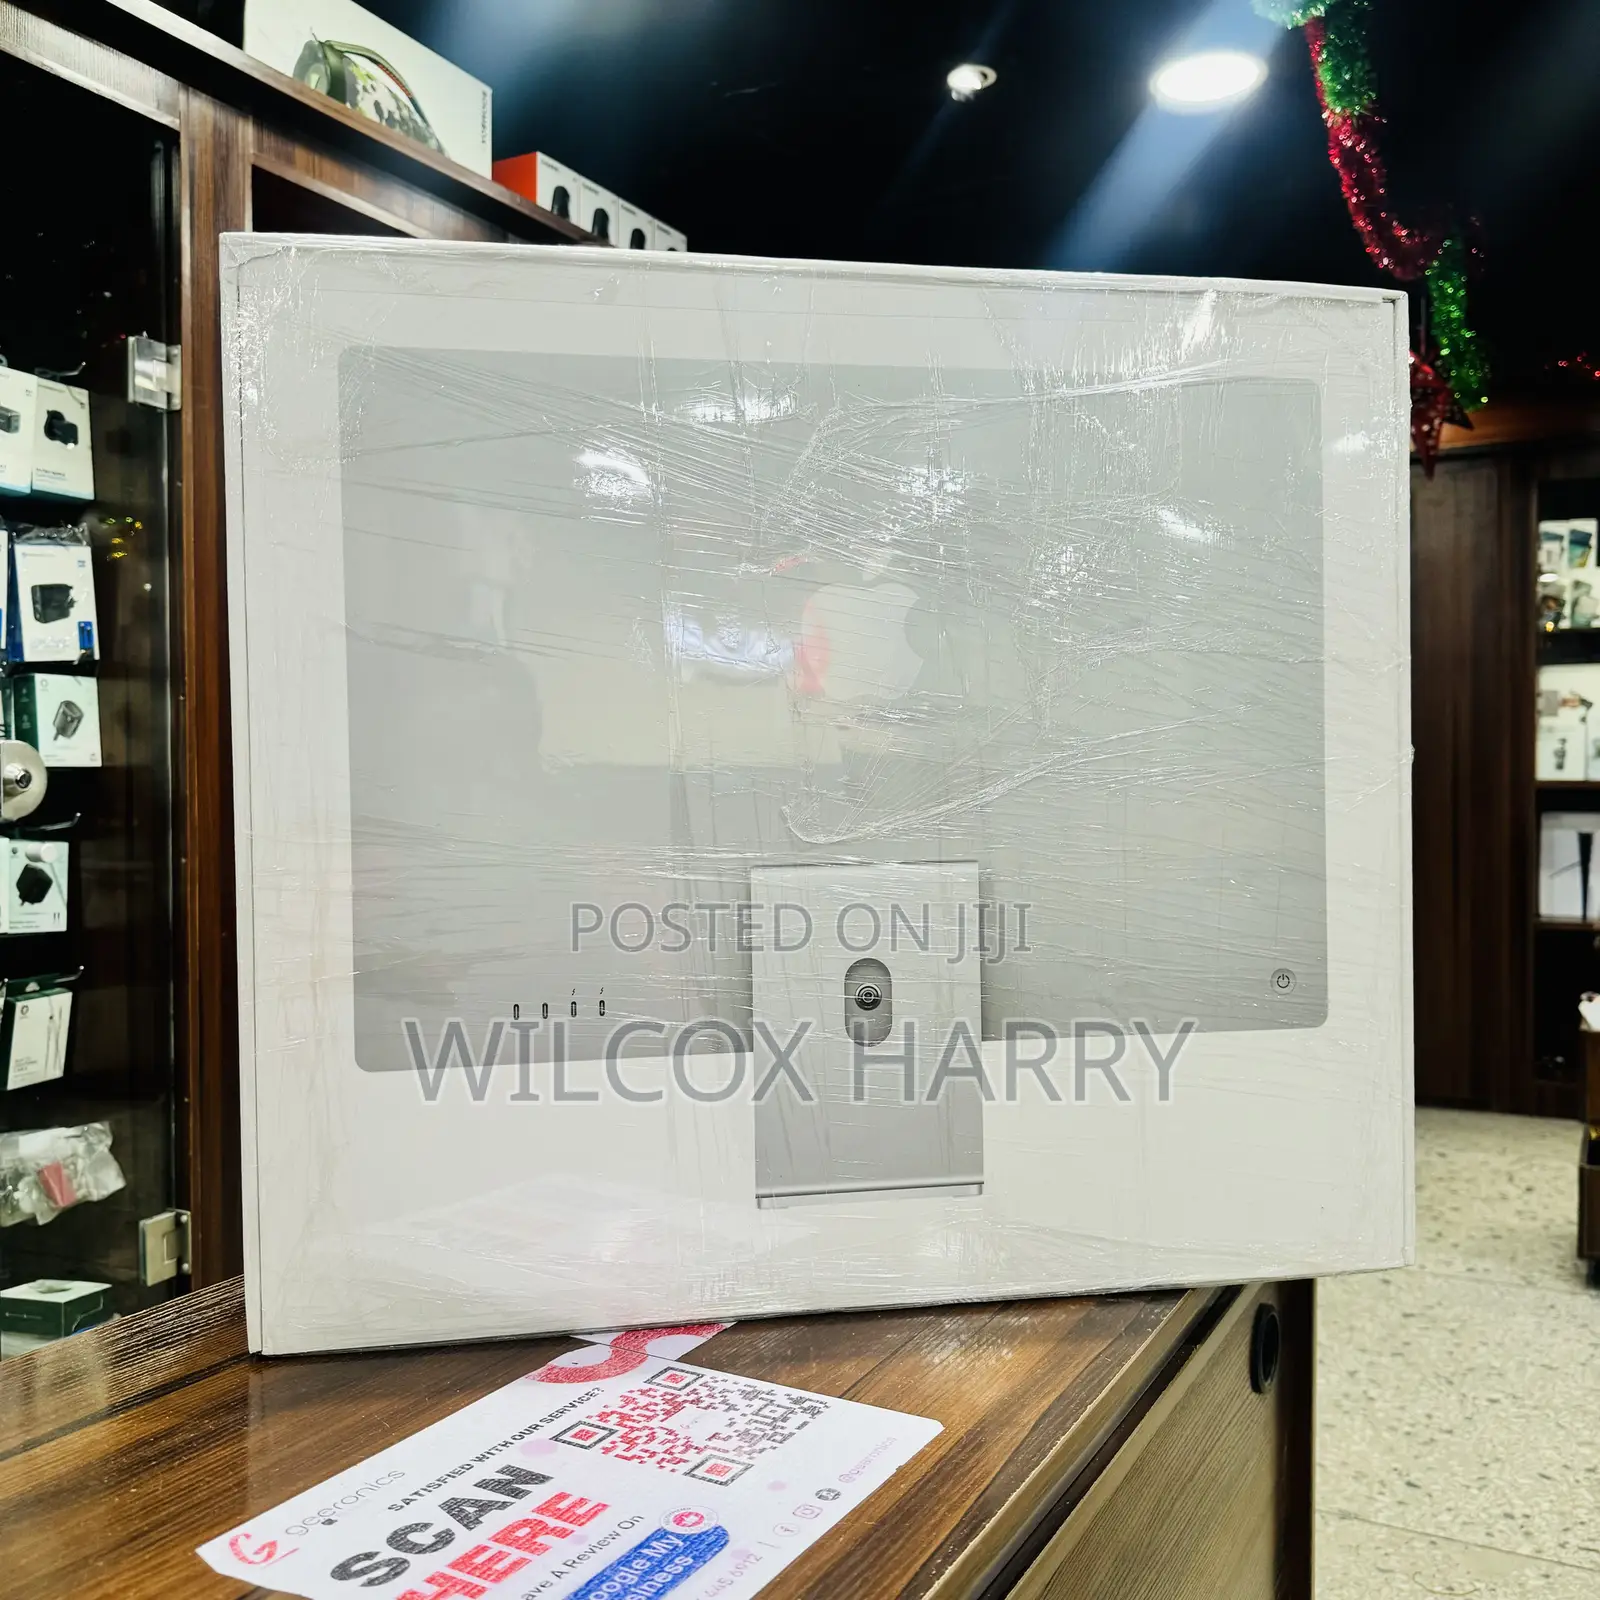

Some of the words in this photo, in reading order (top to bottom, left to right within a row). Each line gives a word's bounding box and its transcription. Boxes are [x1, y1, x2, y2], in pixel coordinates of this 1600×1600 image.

[387, 1462, 475, 1512] SATISFIED
[470, 1439, 515, 1464] WITH
[511, 1422, 544, 1442] OUR
[539, 1386, 606, 1425] SERVICE?
[285, 1469, 406, 1537] geeronics
[330, 1464, 555, 1588] SCAN
[396, 1491, 611, 1600] HERE
[641, 1534, 685, 1559] My
[550, 1570, 571, 1580] A
[562, 1529, 623, 1569] Review
[617, 1515, 645, 1531] On
